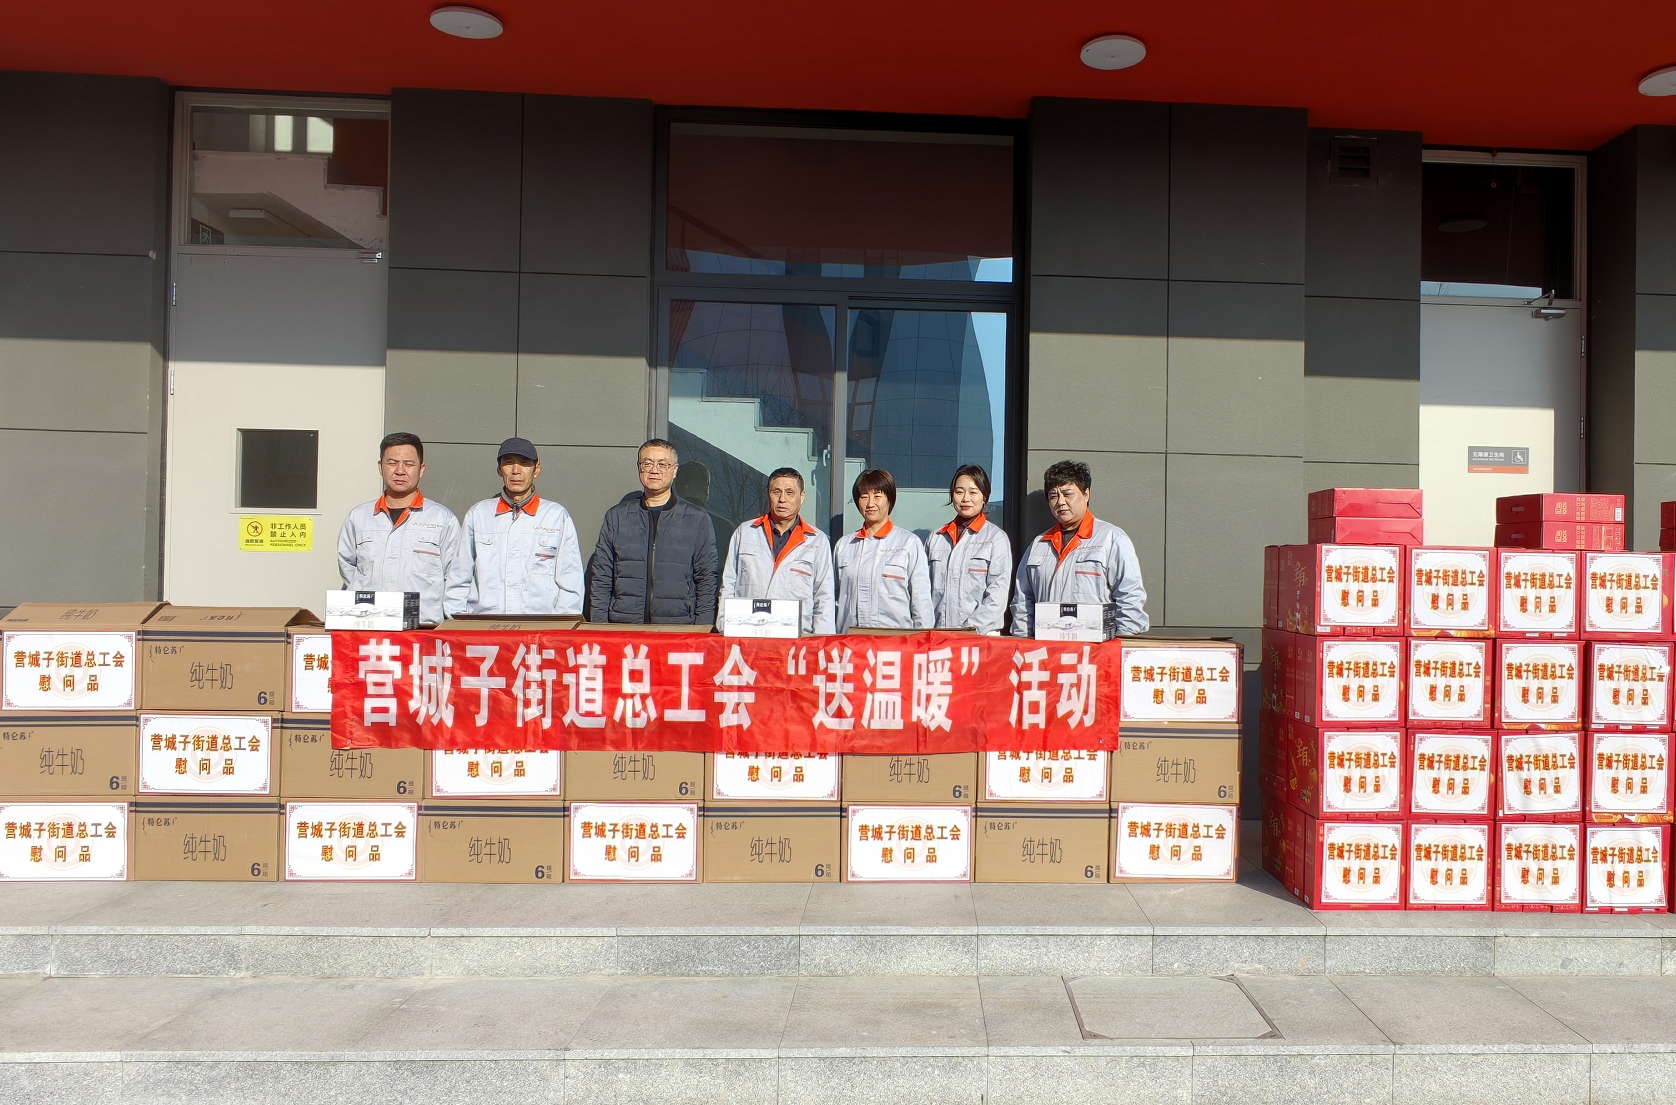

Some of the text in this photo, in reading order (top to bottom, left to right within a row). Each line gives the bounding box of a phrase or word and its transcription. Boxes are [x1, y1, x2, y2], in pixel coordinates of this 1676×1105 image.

[1326, 565, 1395, 584] 营城子街道总工会
[1415, 568, 1485, 587] 营城子街道总工会
[1504, 572, 1572, 590] 营城子街道总工会
[1590, 572, 1659, 590] 营城子街道总工会
[14, 651, 125, 668] 营城子街道总工会
[1414, 659, 1481, 678] 营城子街道总工会
[189, 661, 234, 690] 纯牛奶
[1131, 666, 1230, 682] 营城子街道总工会
[1327, 660, 1396, 678] 营城子街道总工会
[1506, 662, 1574, 680] 营城子街道总工会
[151, 733, 260, 752] 营城子街道总工会
[40, 747, 84, 775] 纯牛奶
[329, 750, 374, 780] 纯牛奶
[613, 754, 655, 781] 纯牛奶
[1328, 752, 1396, 770] 营城子街道总工会
[1418, 752, 1487, 772] 营城子街道总工会
[1506, 753, 1575, 771] 营城子街道总工会
[1597, 752, 1664, 770] 营城子街道总工会
[889, 757, 930, 784] 纯牛奶
[1156, 757, 1196, 784] 纯牛奶
[5, 822, 116, 839] 营城子街道总工会
[297, 821, 406, 838] 营城子街道总工会
[581, 821, 687, 839] 营城子街道总工会
[859, 824, 961, 841] 营城子街道总工会
[1127, 821, 1226, 839] 营城子街道总工会
[183, 834, 227, 862] 纯牛奶
[469, 836, 512, 864] 纯牛奶
[750, 836, 792, 864] 纯牛奶
[1022, 837, 1062, 864] 纯牛奶
[1328, 842, 1397, 861] 营城子街道总工会
[1415, 843, 1484, 861] 营城子街道总工会
[1505, 843, 1575, 861] 营城子街道总工会
[1591, 846, 1658, 863] 营城子街道总工会
